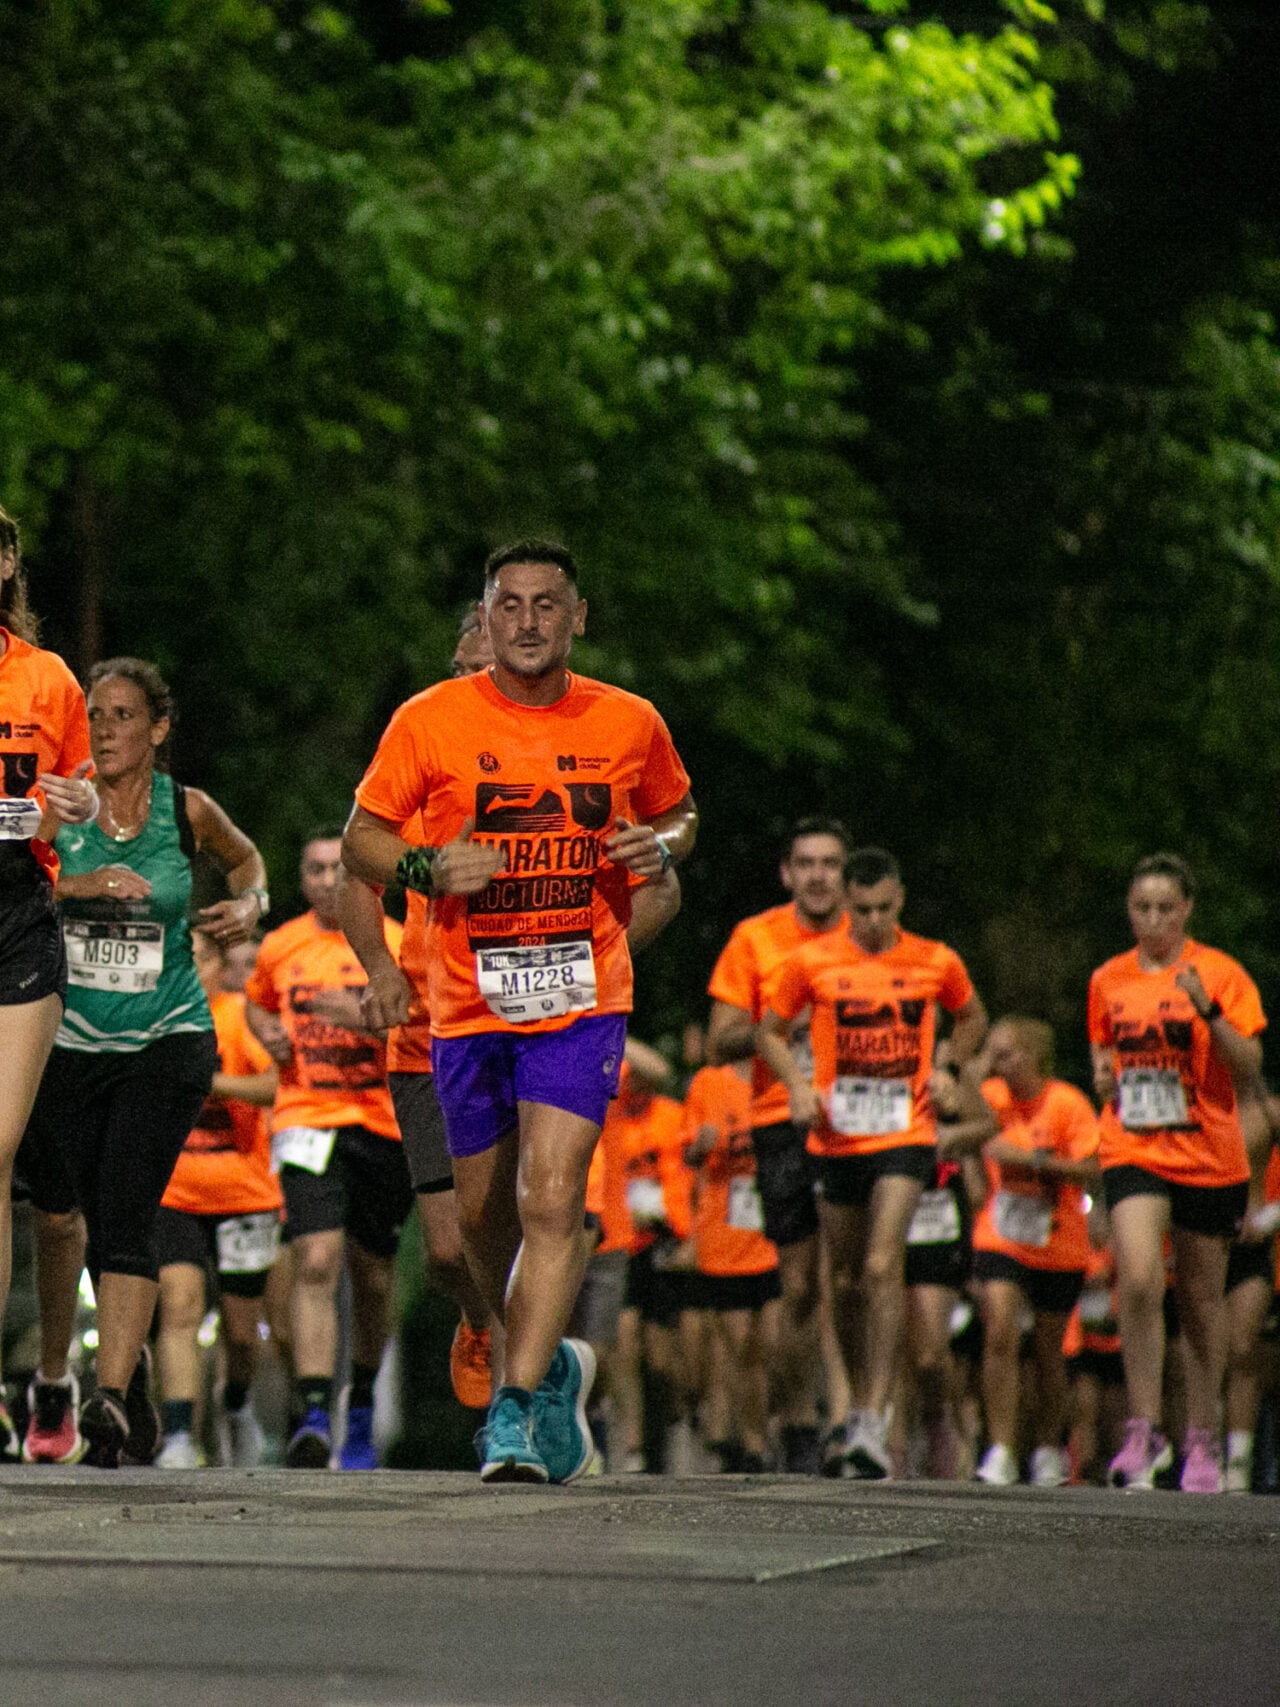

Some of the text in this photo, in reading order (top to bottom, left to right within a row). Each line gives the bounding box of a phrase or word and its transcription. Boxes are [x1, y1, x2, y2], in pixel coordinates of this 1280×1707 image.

[473, 831, 599, 874] ARATÓN
[470, 916, 513, 932] CIUDAD
[518, 916, 533, 931] DE
[83, 939, 140, 965] M903
[501, 965, 575, 996] M1228
